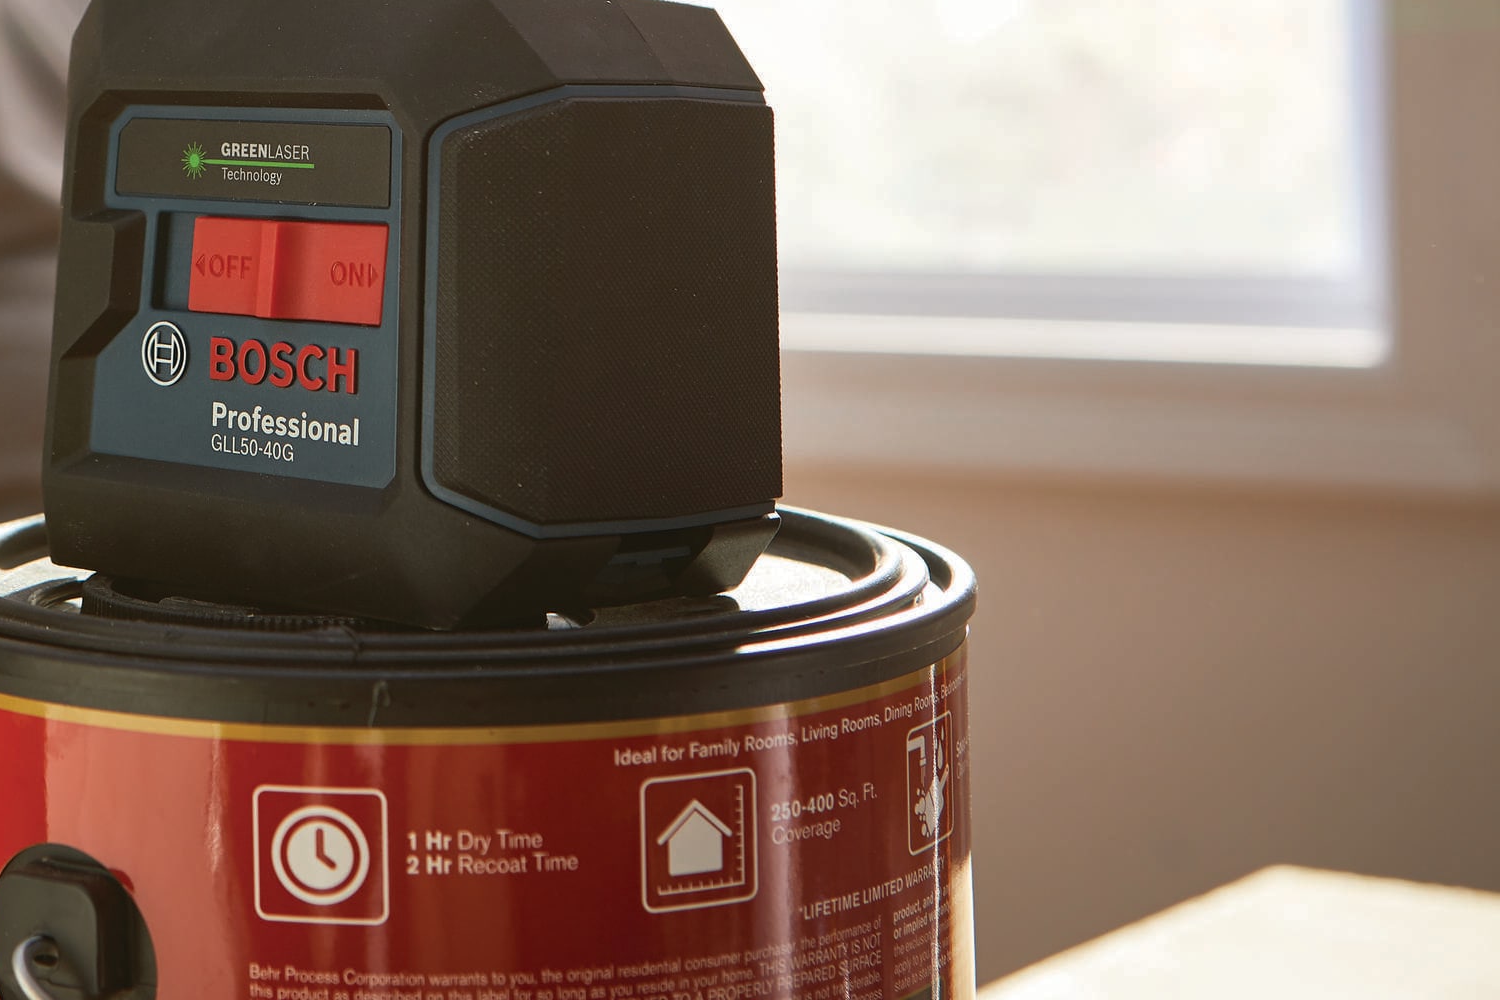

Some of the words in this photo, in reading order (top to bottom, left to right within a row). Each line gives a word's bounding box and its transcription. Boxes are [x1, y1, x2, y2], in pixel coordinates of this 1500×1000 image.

[220, 142, 310, 161] GREENLASER
[221, 166, 282, 186] Technology
[208, 254, 252, 280] OFF
[330, 261, 364, 287] ON
[209, 336, 359, 395] BOSCH
[212, 401, 359, 446] Professional
[211, 433, 294, 462] GLL50-40G
[614, 748, 657, 767] Ideal
[661, 744, 685, 762] for
[689, 738, 740, 759] Family
[745, 731, 798, 751] Rooms,
[802, 721, 838, 743] Living
[841, 712, 882, 734] Rooms,
[884, 699, 912, 723] Dining
[771, 792, 834, 822] 250-400
[838, 788, 859, 808] Sq.
[863, 782, 878, 801] Ft.
[407, 831, 417, 851] 1
[426, 830, 452, 850] Hr
[457, 829, 491, 856] Dry
[496, 828, 543, 849] Time
[771, 818, 841, 845] Coverage
[406, 854, 420, 875] 2
[426, 854, 452, 875] Hr
[458, 854, 528, 875] Recoat
[533, 851, 579, 873] Time
[863, 877, 903, 905] LIMITED
[905, 856, 946, 889] WARRATY
[249, 963, 280, 981] Behr
[285, 965, 340, 985] Process
[343, 967, 425, 988] Corporation
[428, 971, 488, 987] warrants
[492, 971, 506, 985] to
[541, 969, 563, 984] the
[566, 965, 615, 985] original
[618, 957, 681, 978] residential
[685, 952, 741, 971] consumer
[250, 983, 273, 998] this
[693, 974, 717, 992] your
[758, 959, 787, 977] THIS
[863, 932, 882, 949] NOT
